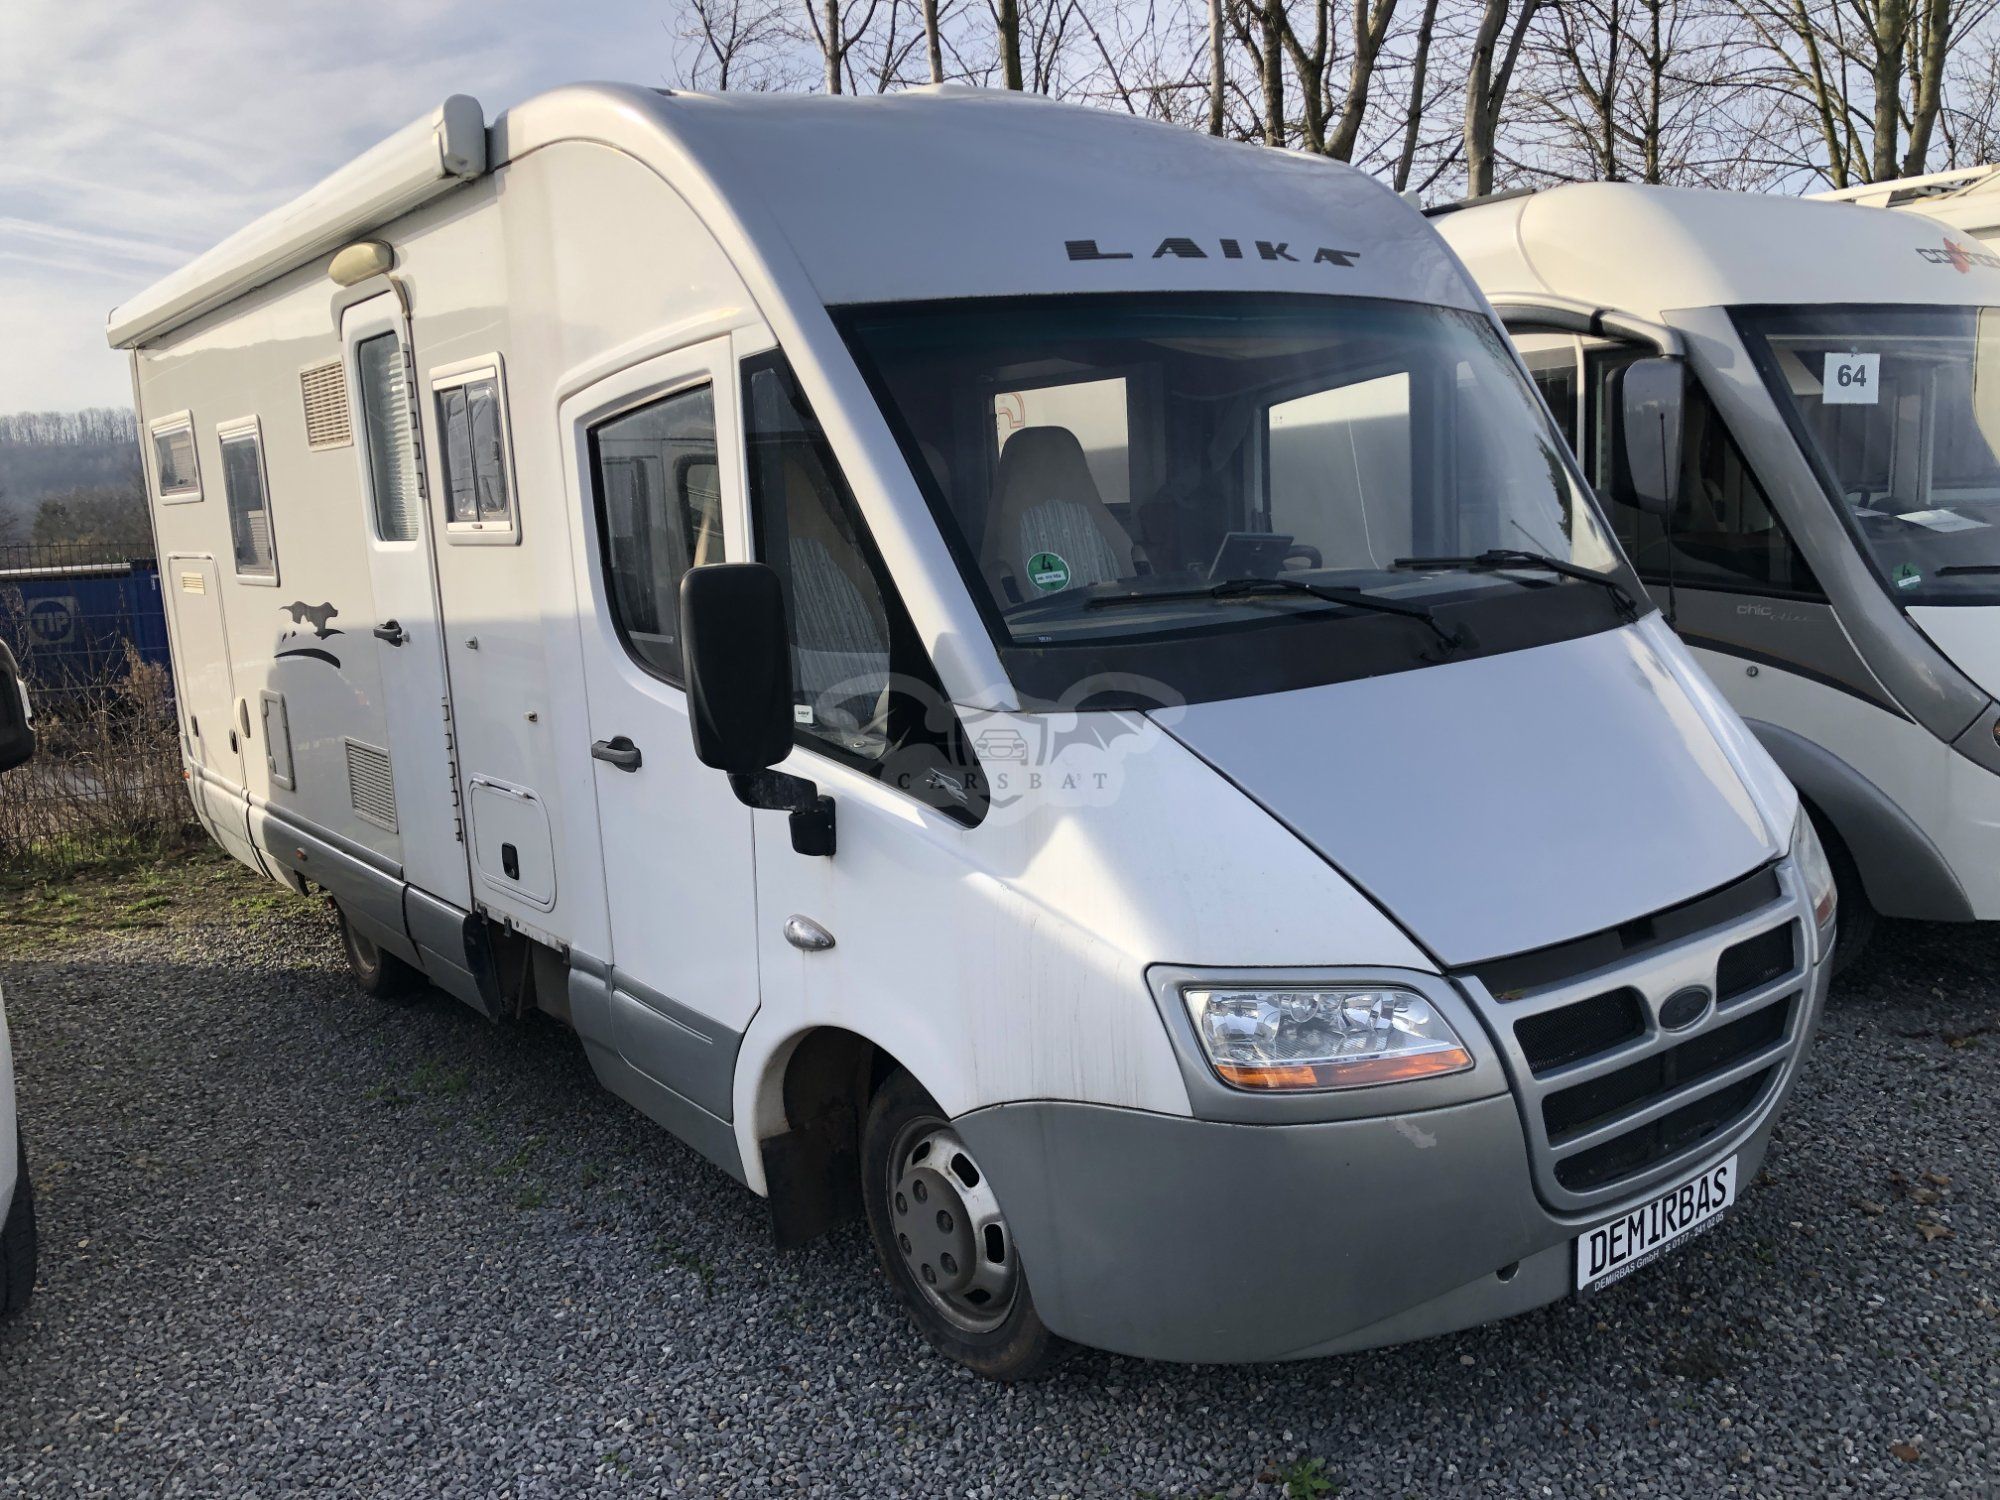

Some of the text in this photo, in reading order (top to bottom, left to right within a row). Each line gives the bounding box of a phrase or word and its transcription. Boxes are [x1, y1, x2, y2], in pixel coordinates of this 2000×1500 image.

[1064, 237, 1361, 268] LAIKA
[1837, 364, 1867, 388] 64
[1041, 555, 1053, 572] 4
[32, 611, 70, 633] TIP
[1736, 604, 1772, 616] chic
[1589, 1166, 1727, 1277] DEMIRBAS
[1594, 1262, 1636, 1292] DEMIRBAS
[1636, 1249, 1660, 1269] GmbH
